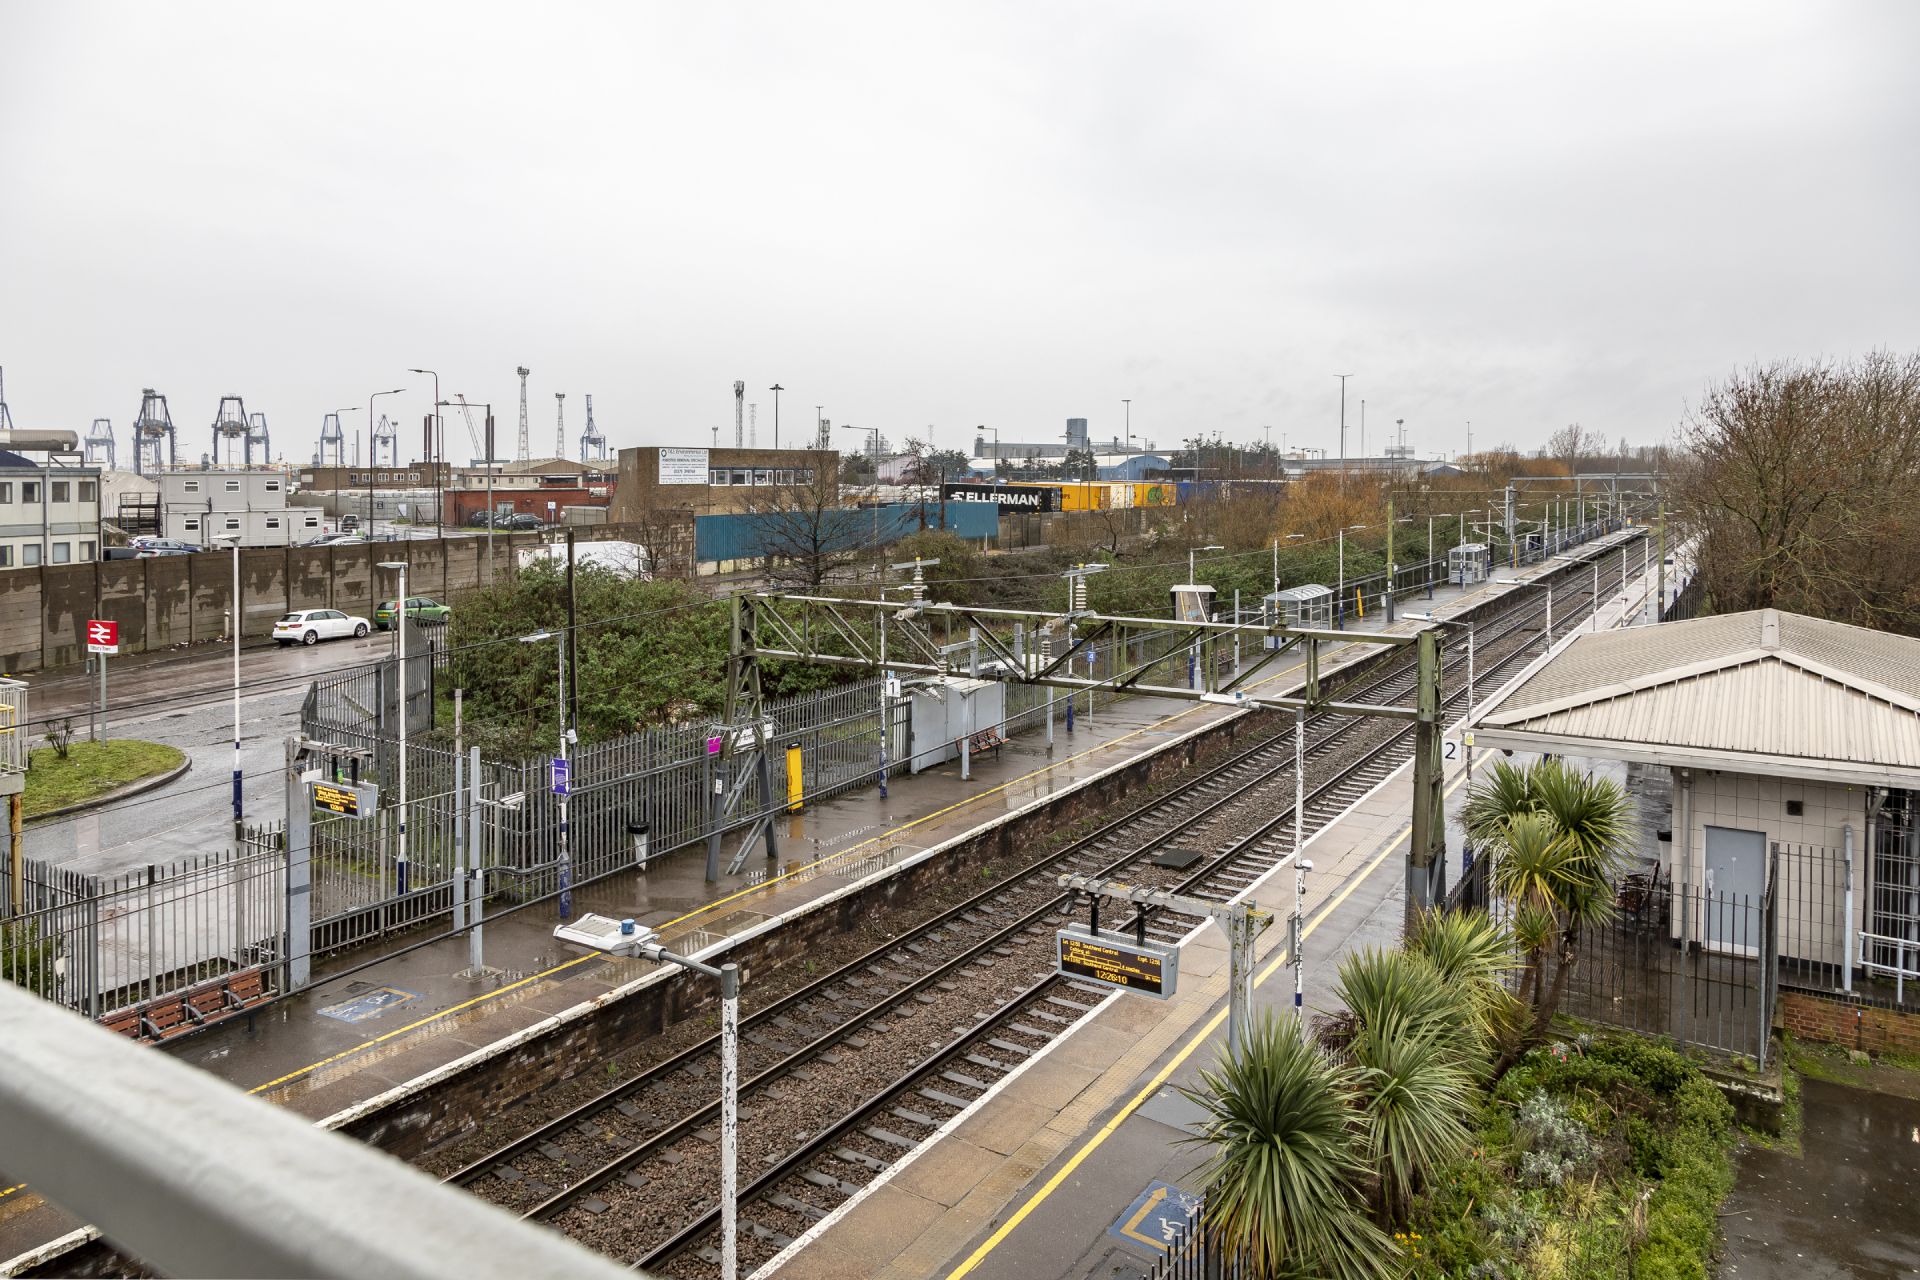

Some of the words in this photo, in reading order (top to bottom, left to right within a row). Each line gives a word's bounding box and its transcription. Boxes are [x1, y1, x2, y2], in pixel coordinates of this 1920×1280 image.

[966, 491, 1038, 506] ELLERMAN
[890, 682, 894, 694] 1
[1445, 742, 1456, 760] 2
[1095, 970, 1128, 984] 12:26:10
